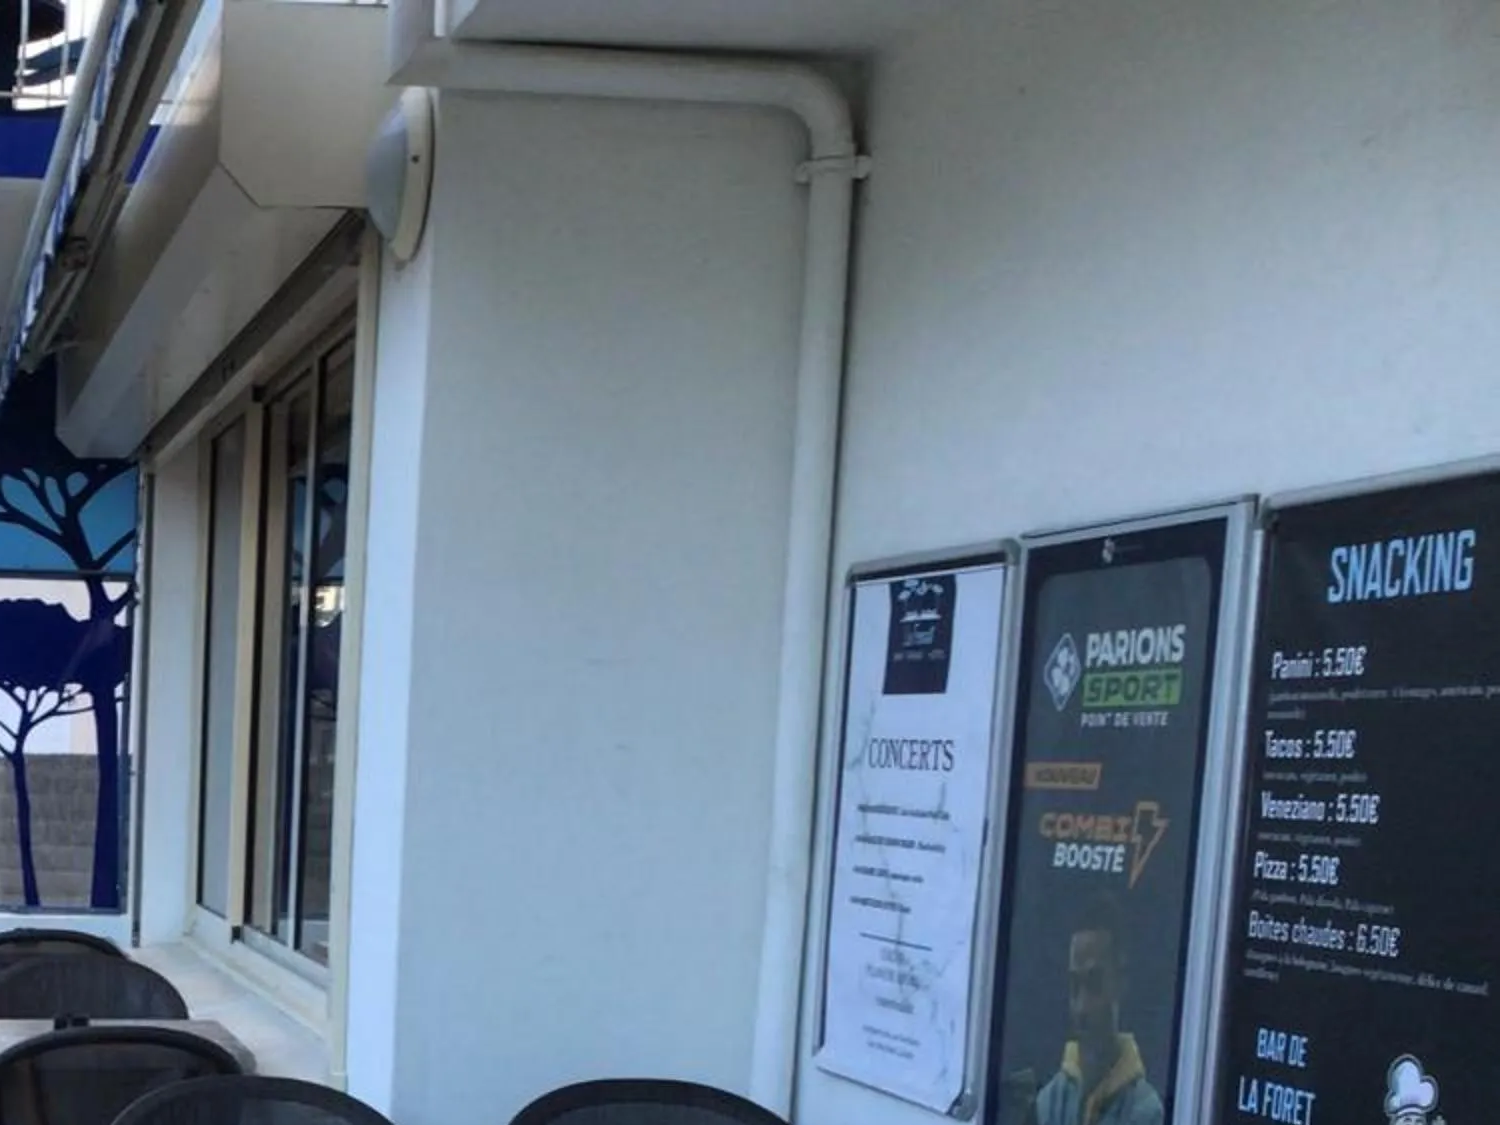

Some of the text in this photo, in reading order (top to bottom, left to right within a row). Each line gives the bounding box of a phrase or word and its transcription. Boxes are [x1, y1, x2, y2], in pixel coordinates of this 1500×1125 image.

[1328, 529, 1476, 603] SNACKING
[1085, 623, 1187, 668] PARIONS
[1270, 651, 1314, 680] Panini
[1085, 672, 1180, 703] SPORT
[867, 736, 956, 773] CONCERTS
[1265, 730, 1303, 759] Tacos
[1253, 851, 1288, 881] Pizza
[1256, 1027, 1309, 1068] BAR DE
[1238, 1075, 1259, 1114] LA
